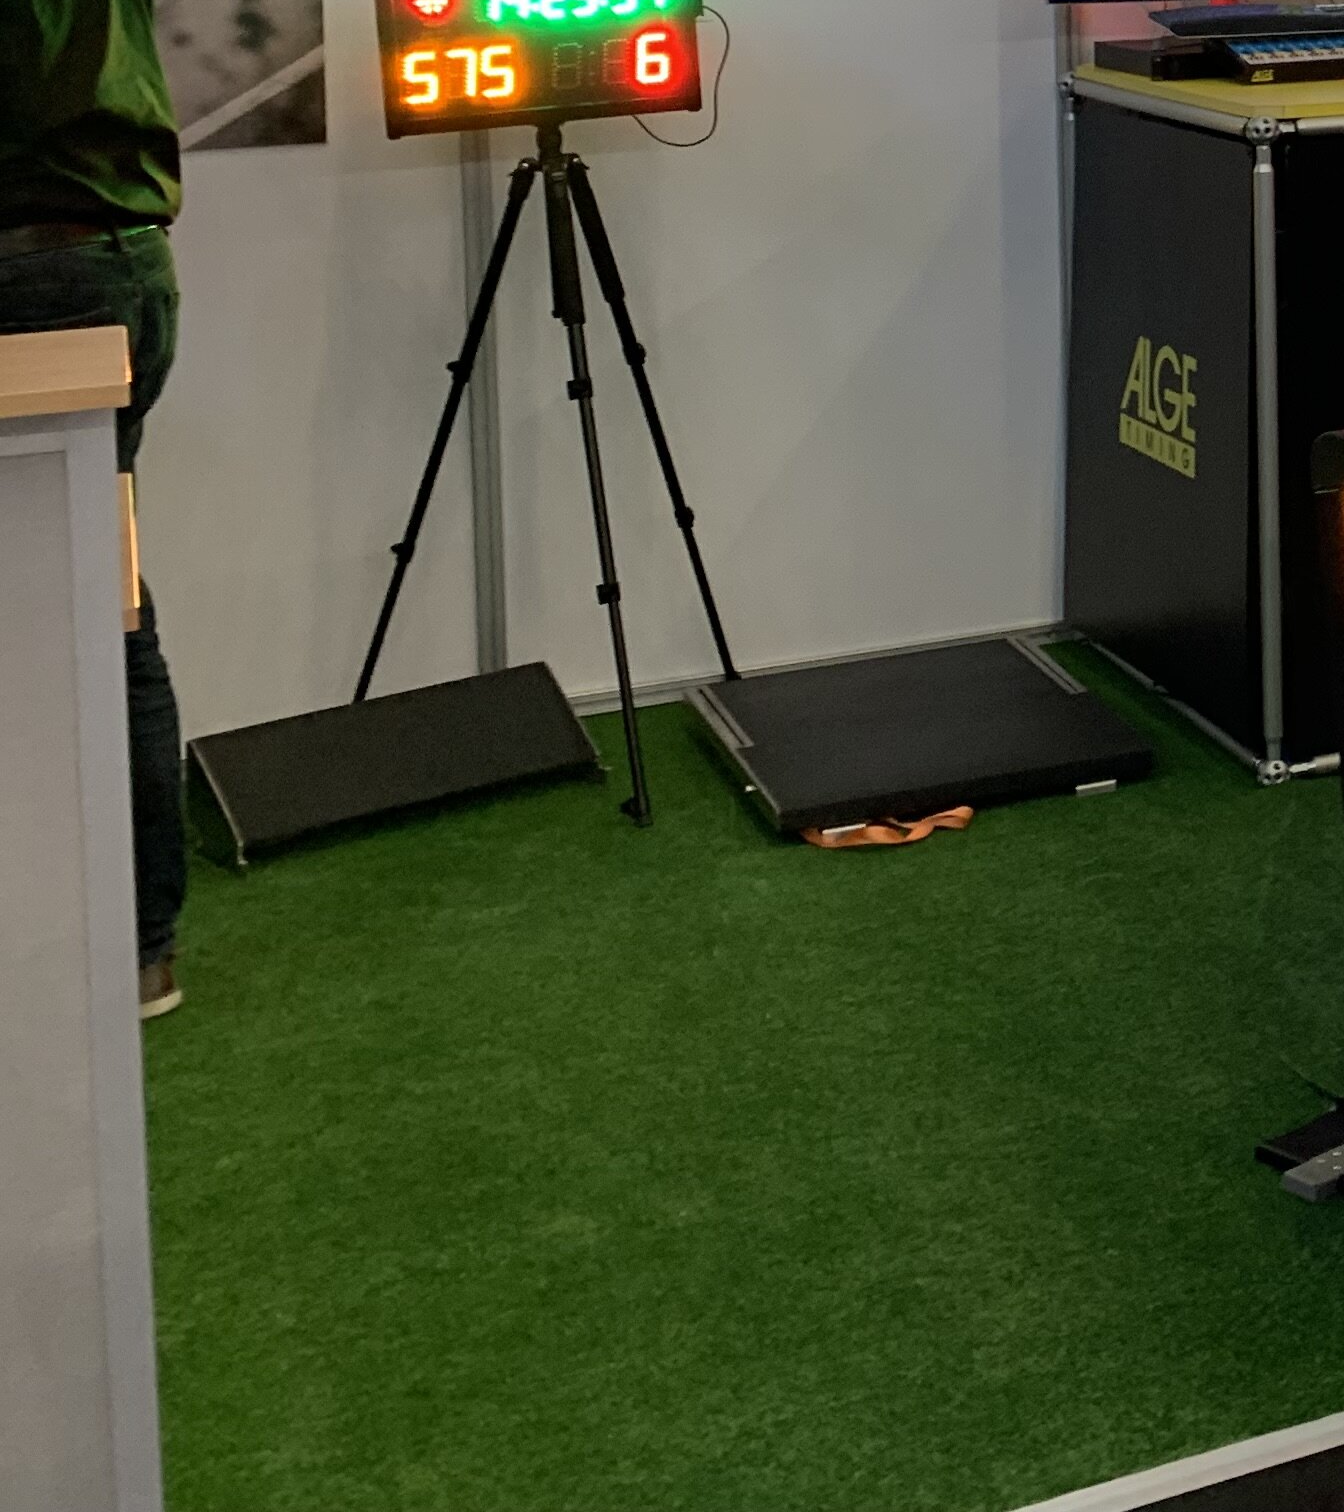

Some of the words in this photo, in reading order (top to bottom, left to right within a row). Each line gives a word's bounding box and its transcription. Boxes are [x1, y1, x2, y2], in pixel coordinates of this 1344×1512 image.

[402, 45, 514, 105] 575
[635, 33, 669, 84] 6
[1121, 336, 1198, 442] ALGE
